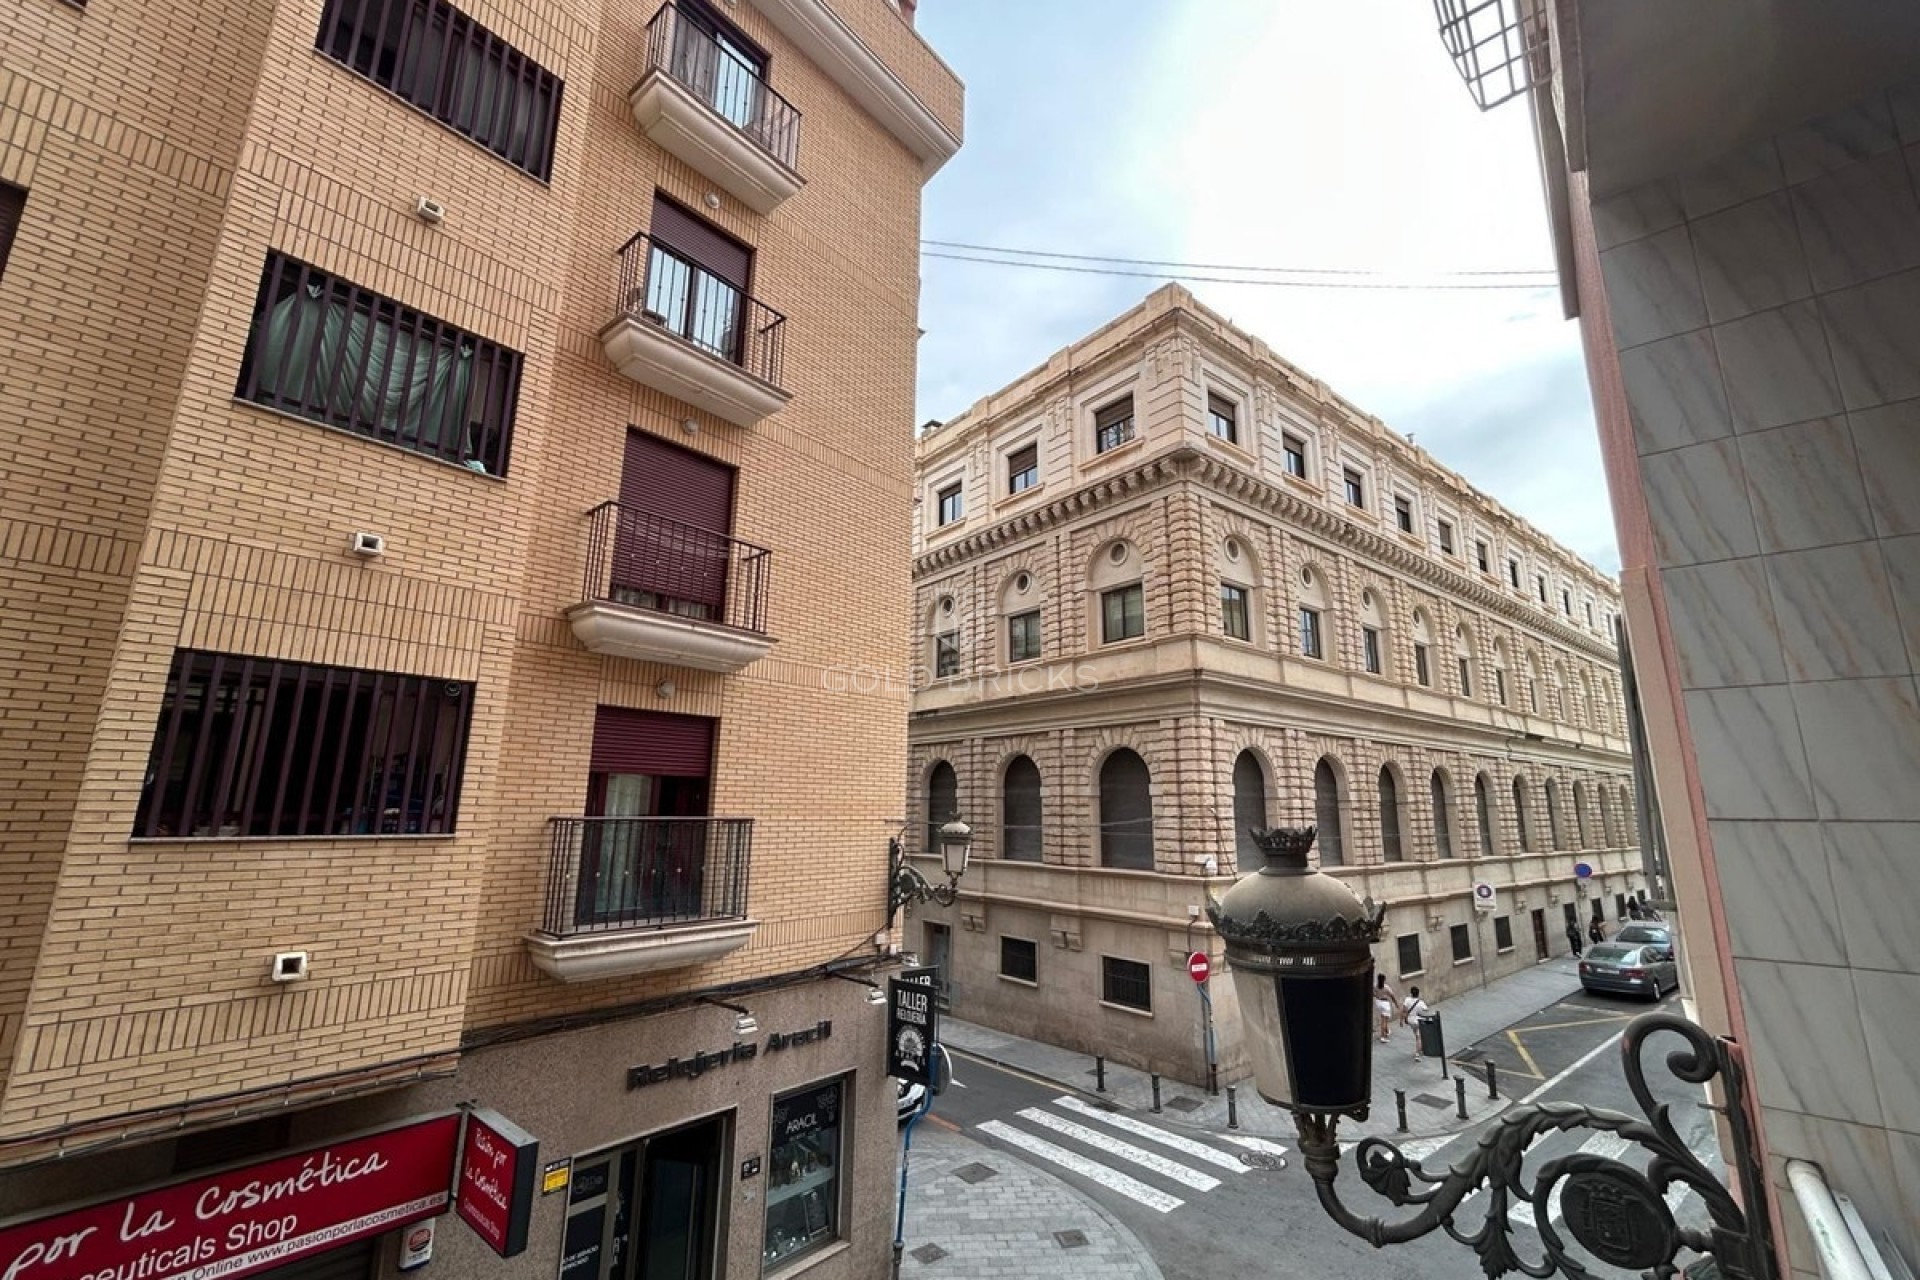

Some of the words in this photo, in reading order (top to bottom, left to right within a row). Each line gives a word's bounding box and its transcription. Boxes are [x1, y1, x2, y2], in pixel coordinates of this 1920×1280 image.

[896, 988, 927, 1012] TALLER
[763, 1020, 832, 1056] Aracil
[195, 1151, 389, 1220] Cosmética
[225, 1214, 297, 1251] Shop
[191, 1255, 243, 1280] Online
